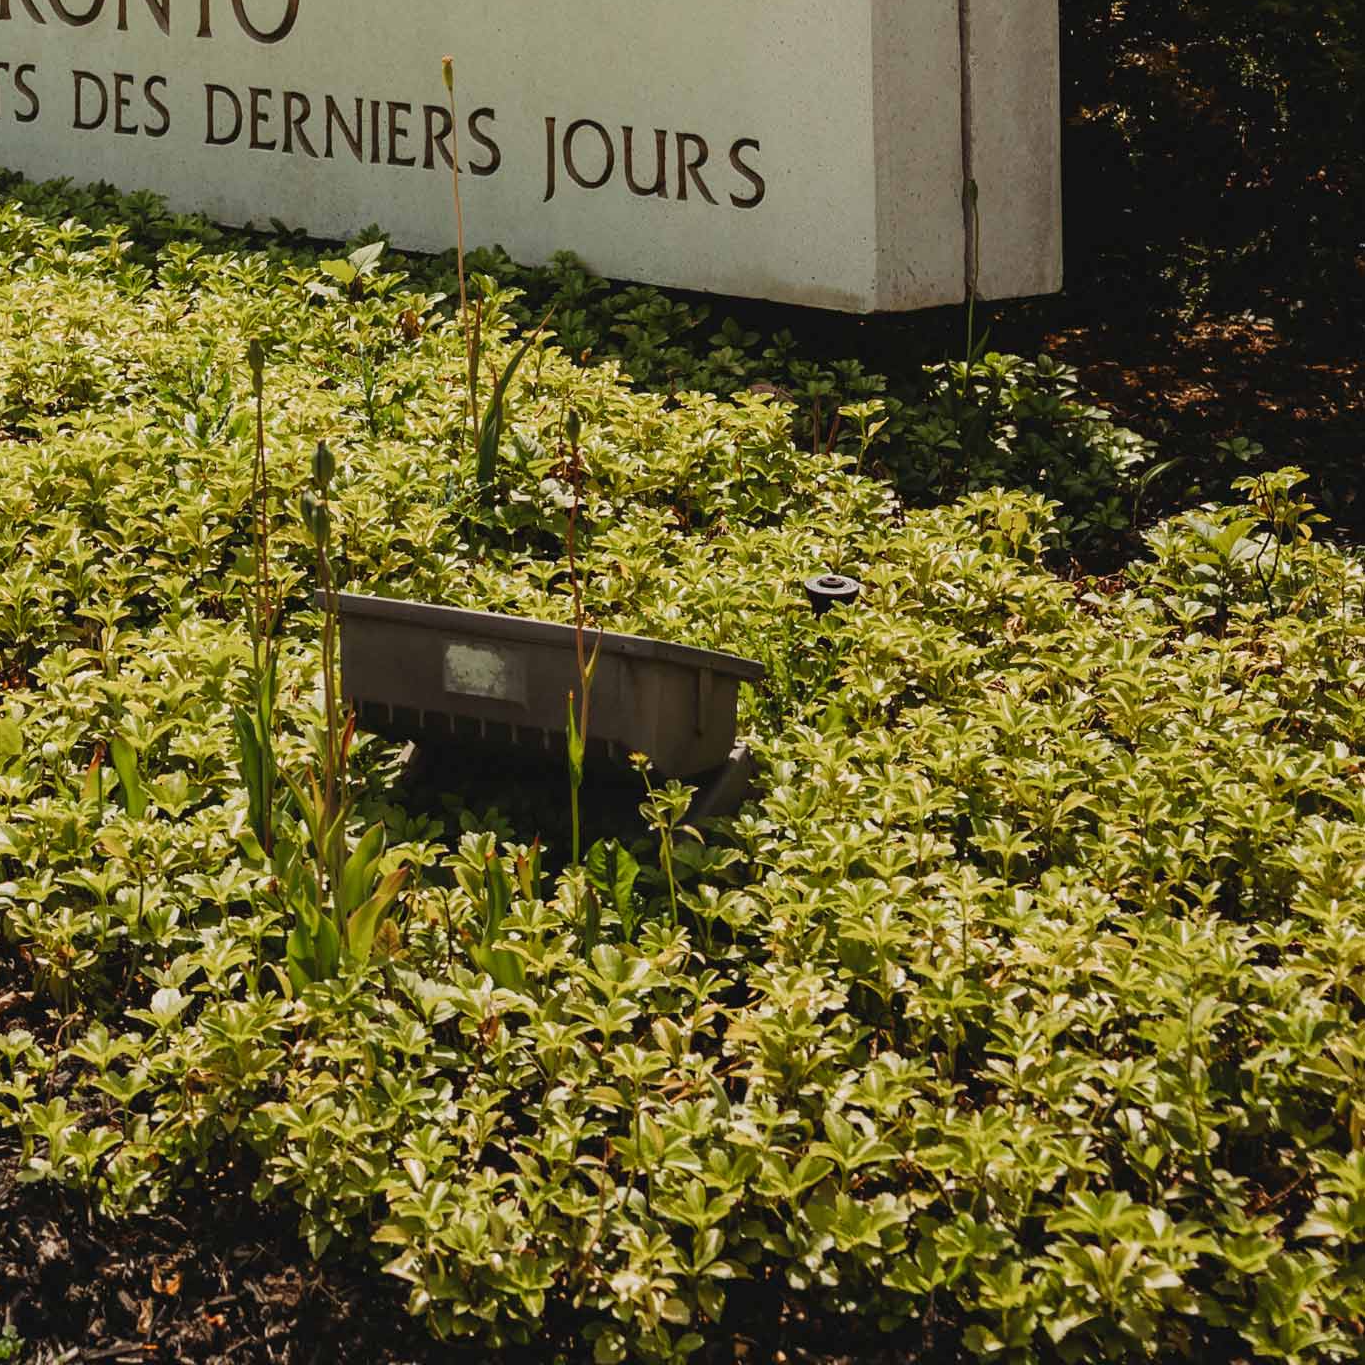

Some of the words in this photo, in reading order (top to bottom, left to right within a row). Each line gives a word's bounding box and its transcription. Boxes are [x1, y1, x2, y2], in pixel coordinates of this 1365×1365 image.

[72, 69, 170, 137] DES
[204, 83, 501, 177] DERNIERS
[543, 116, 766, 209] JOURS
